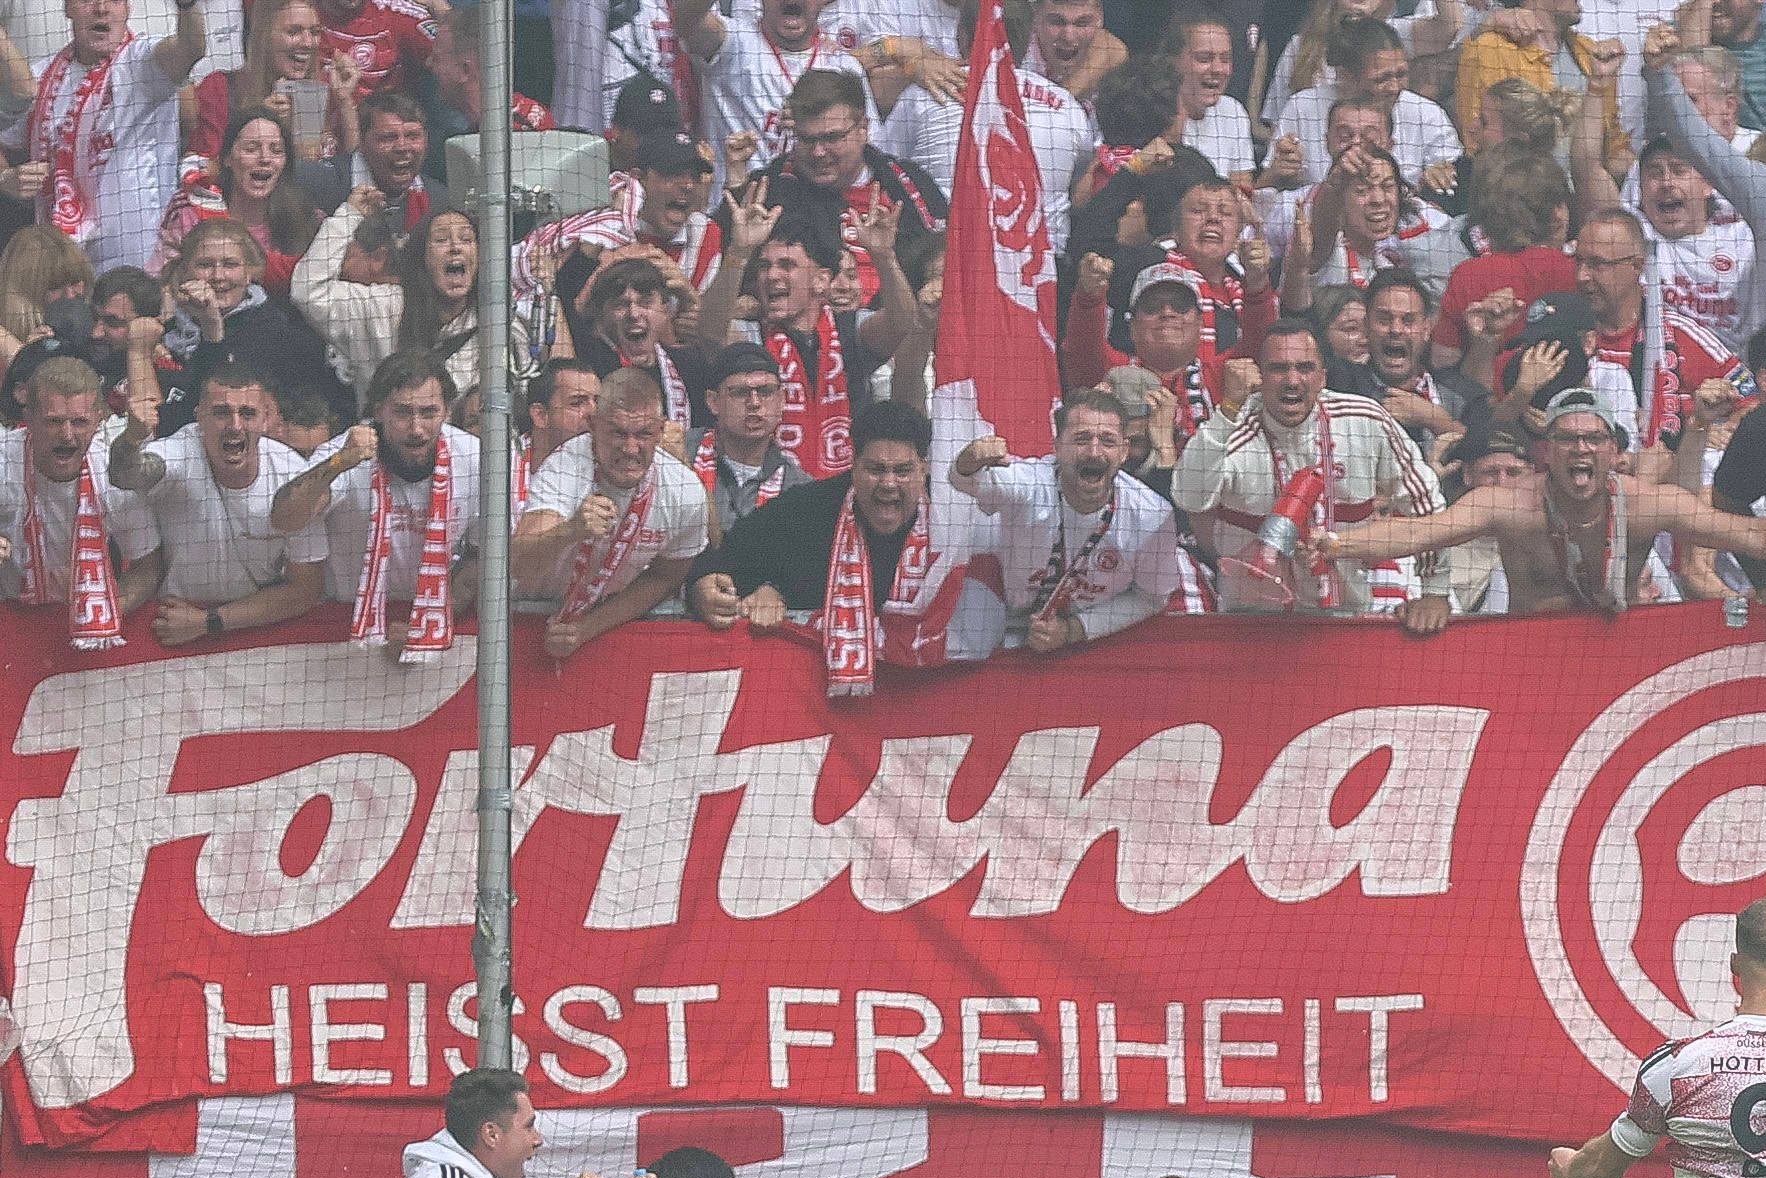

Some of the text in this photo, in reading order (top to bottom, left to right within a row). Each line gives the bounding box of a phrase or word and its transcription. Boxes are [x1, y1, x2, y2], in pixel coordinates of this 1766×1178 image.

[4, 635, 1491, 1108] Fortuna
[203, 982, 1424, 1105] HEISST FREIHEIT
